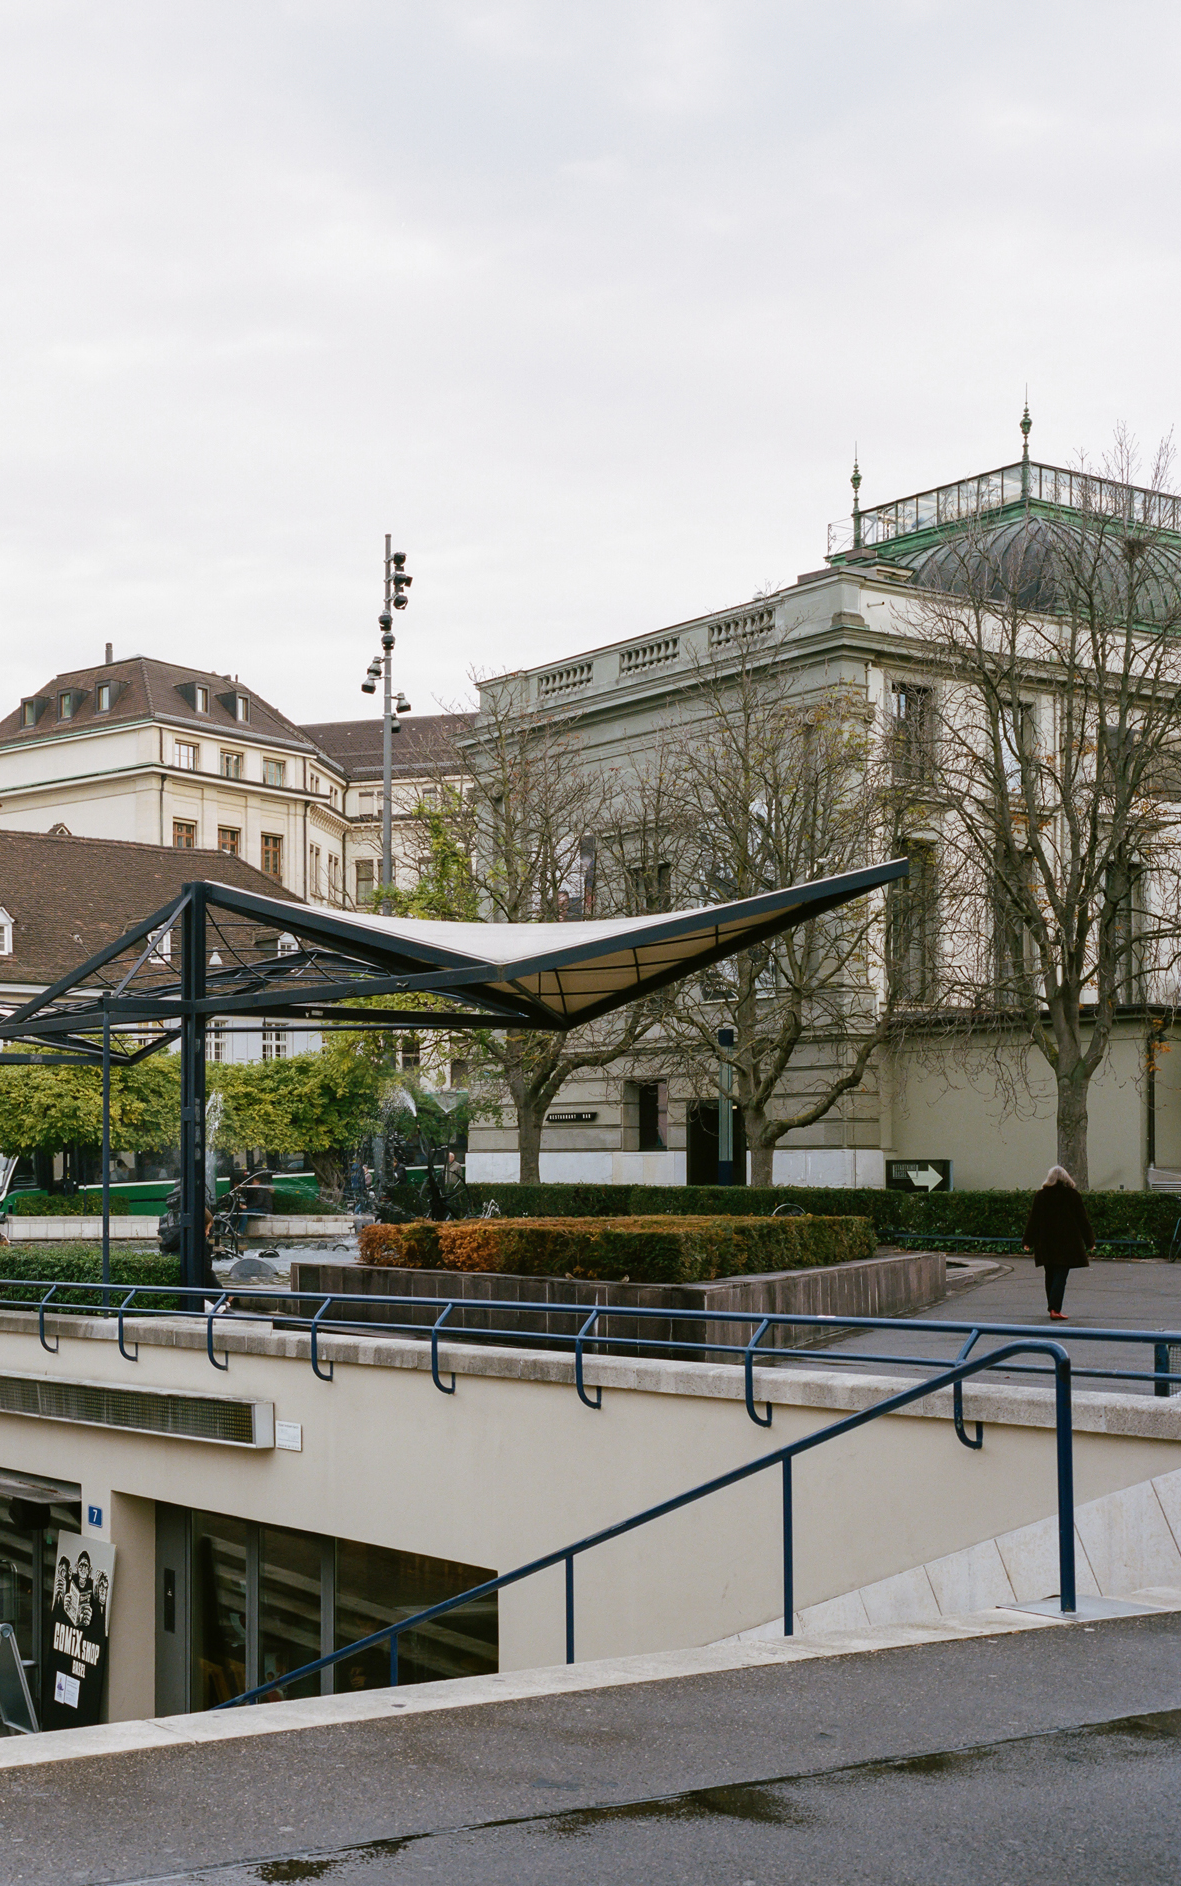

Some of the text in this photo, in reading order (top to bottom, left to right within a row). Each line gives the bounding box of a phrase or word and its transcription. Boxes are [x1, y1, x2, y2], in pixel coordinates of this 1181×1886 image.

[92, 1509, 98, 1522] 7
[82, 1639, 100, 1666] SHOP
[71, 1659, 86, 1679] BASEL
